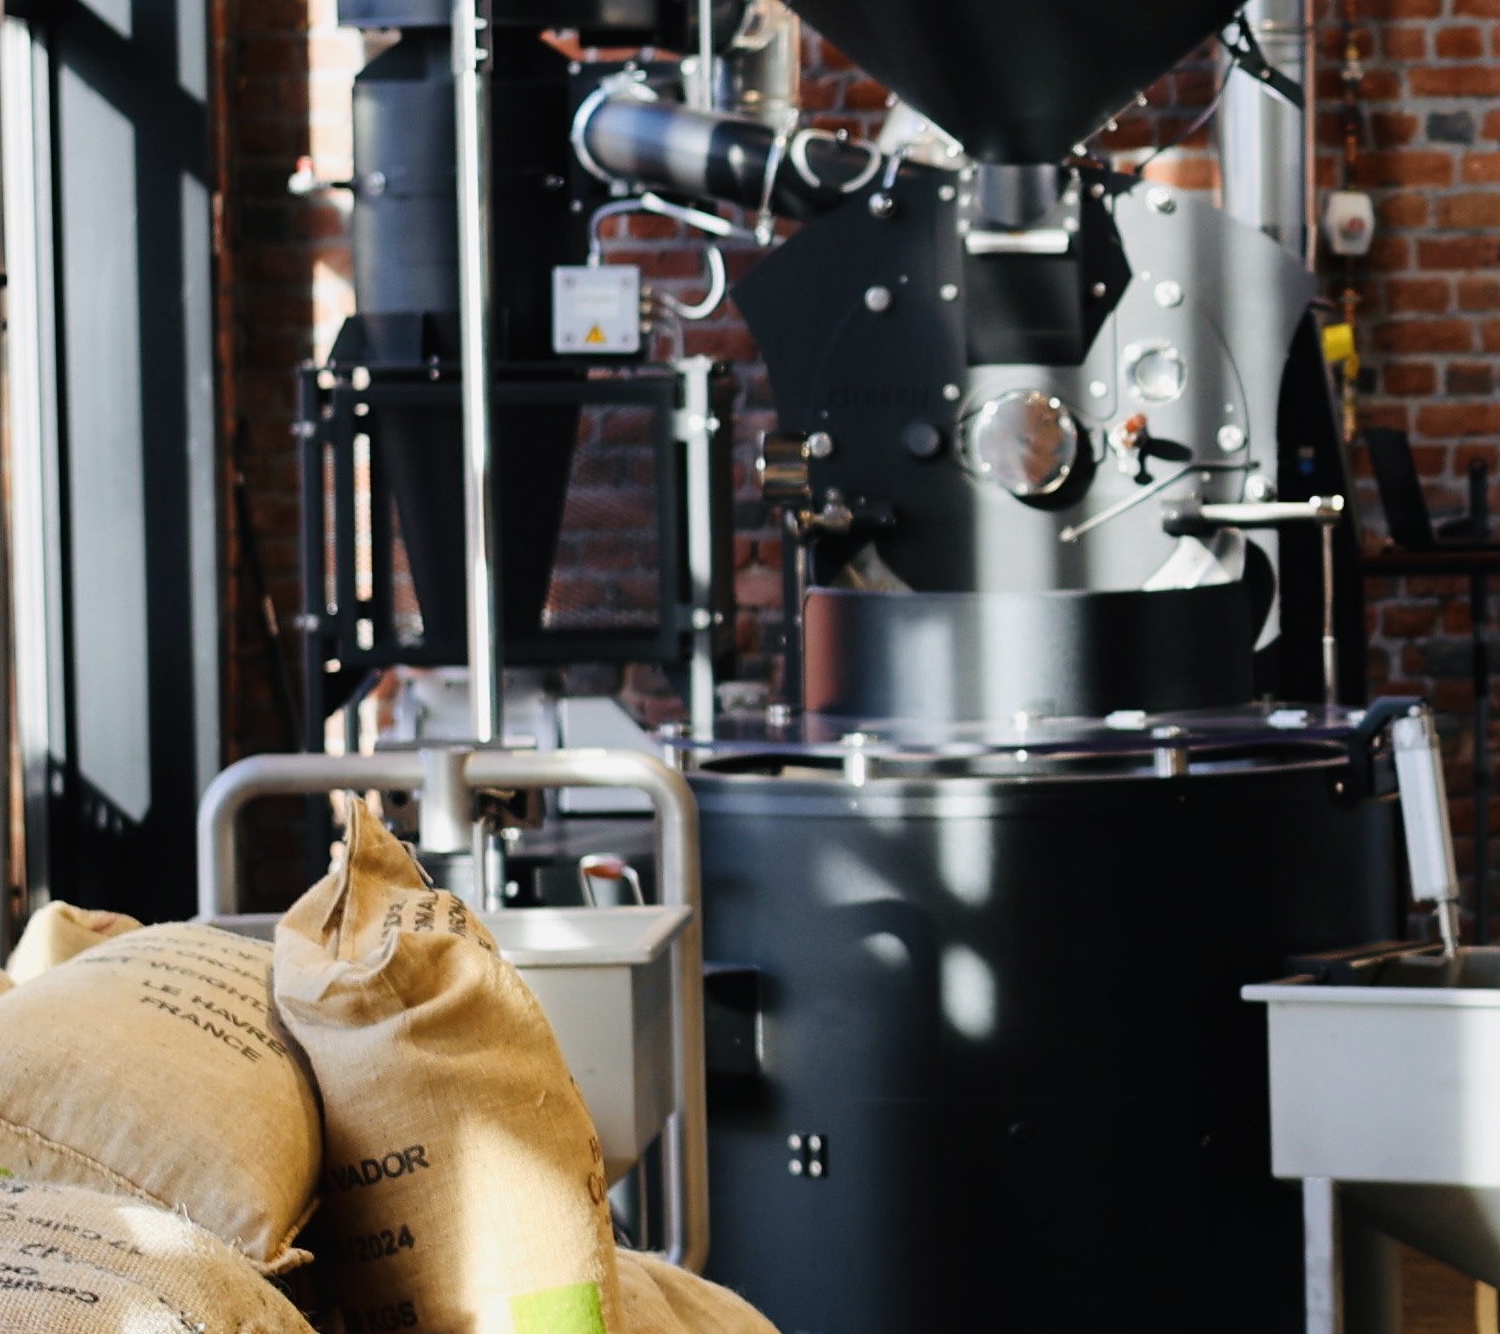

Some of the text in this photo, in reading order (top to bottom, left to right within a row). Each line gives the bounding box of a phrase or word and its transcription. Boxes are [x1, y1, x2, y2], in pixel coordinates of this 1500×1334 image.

[140, 995, 263, 1063] FRANCE
[141, 979, 289, 1058] LE HAVRE
